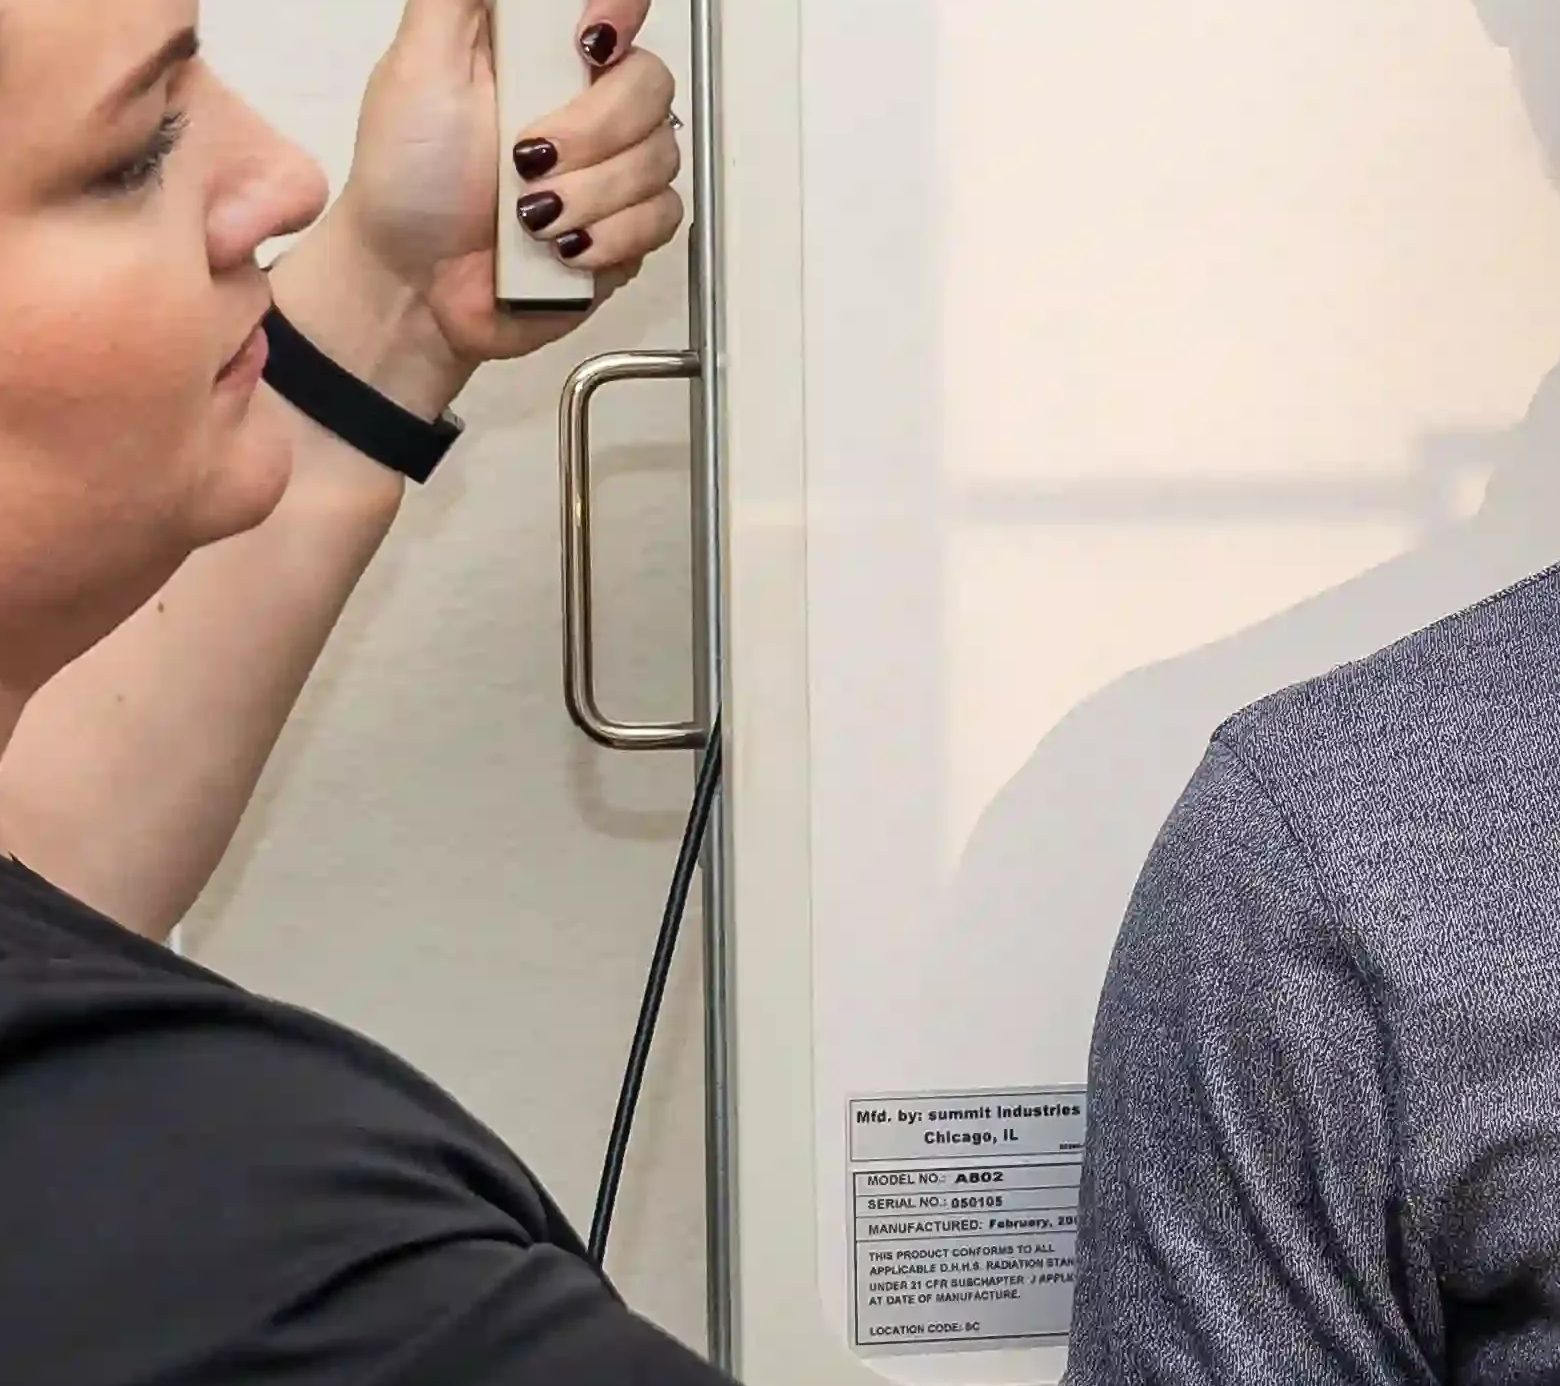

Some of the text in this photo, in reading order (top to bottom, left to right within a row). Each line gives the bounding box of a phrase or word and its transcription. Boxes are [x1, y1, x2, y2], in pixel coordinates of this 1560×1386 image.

[856, 1109, 891, 1124] Mfd.
[898, 1109, 922, 1125] by:
[997, 1104, 1080, 1119] Industries
[924, 1128, 1019, 1145] Chicago, IL
[867, 1173, 915, 1186] MODEL
[867, 1197, 916, 1210] SERIAL
[951, 1195, 1003, 1209] 050105
[868, 1219, 983, 1235] MANUFACTURED:
[989, 1218, 1053, 1230] February,
[868, 1243, 1056, 1262] THIS PRODUCT CONFORMS TO ALL
[869, 1263, 937, 1276] APPLICABLE
[986, 1258, 1044, 1270] RADIATION
[869, 1280, 908, 1292] UNDER
[910, 1280, 922, 1290] 21
[925, 1278, 948, 1290] CFR
[951, 1274, 1025, 1288] SUBCHAPTER
[868, 1288, 1021, 1306] AT DATE OF MANUFACTURE.
[869, 1324, 925, 1336] LOCATION
[927, 1322, 962, 1333] CODE:
